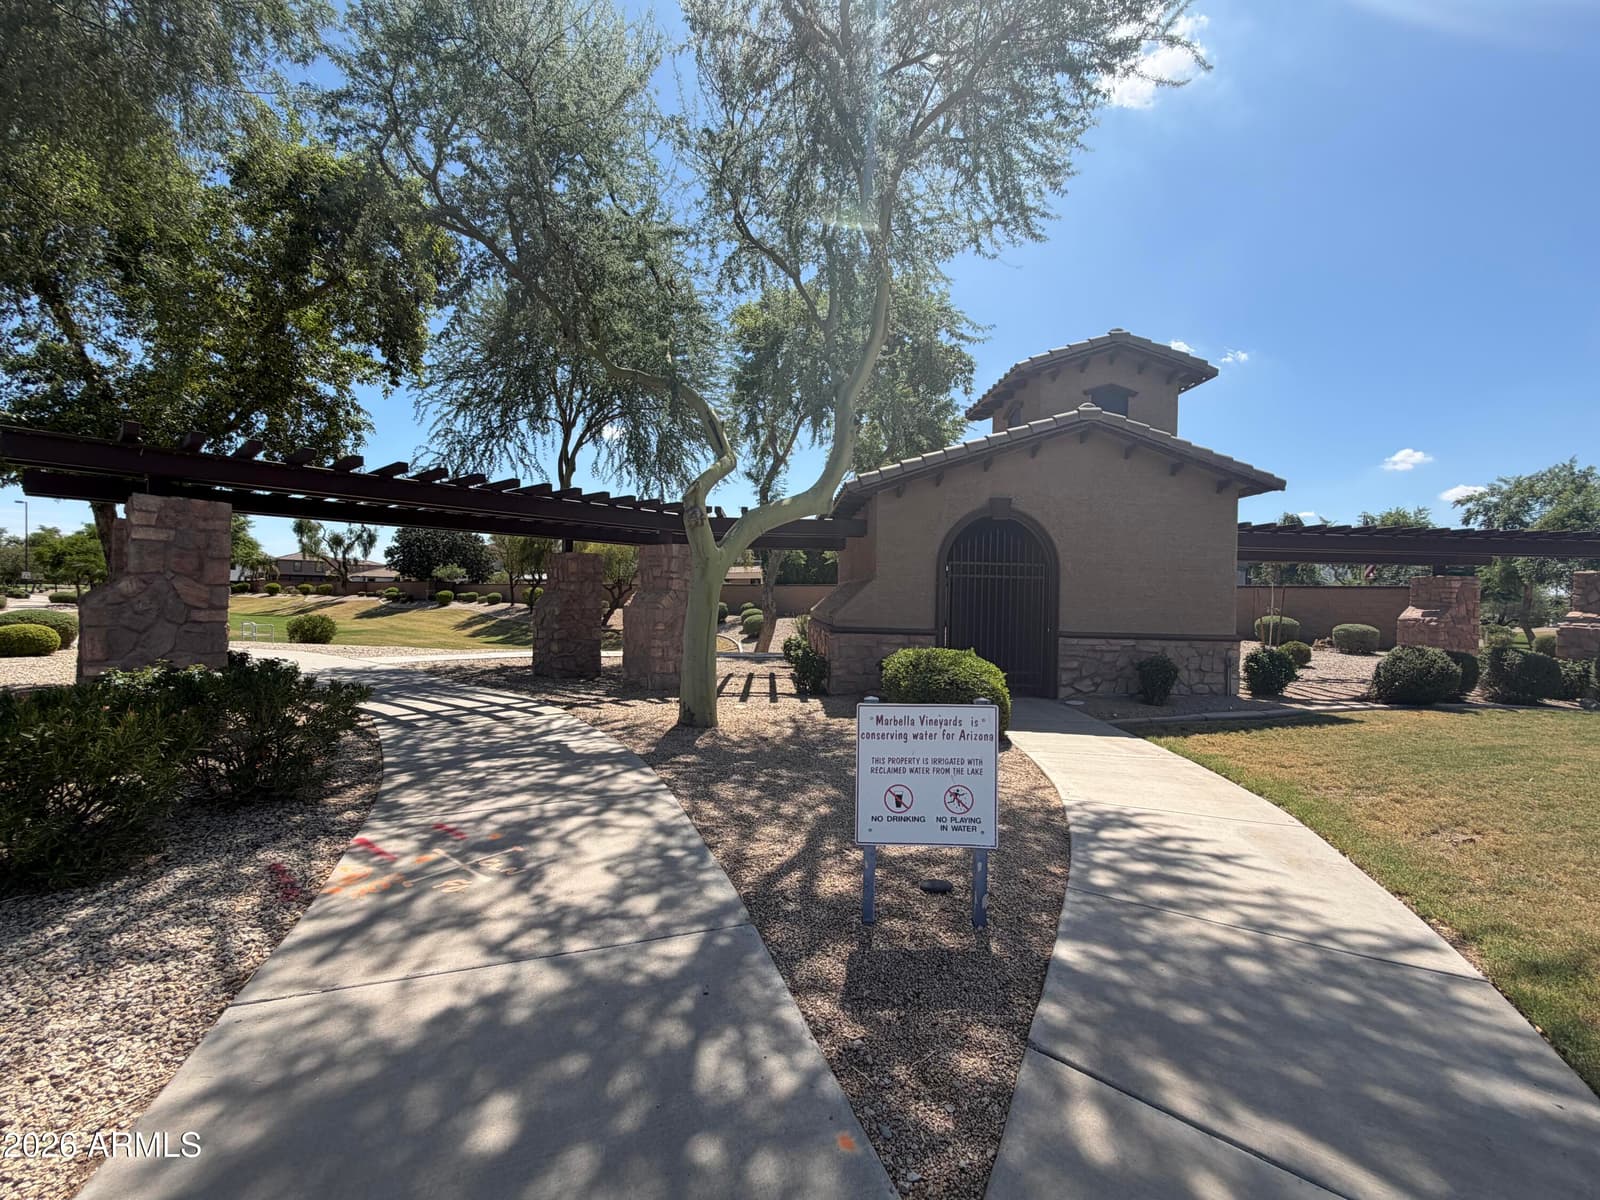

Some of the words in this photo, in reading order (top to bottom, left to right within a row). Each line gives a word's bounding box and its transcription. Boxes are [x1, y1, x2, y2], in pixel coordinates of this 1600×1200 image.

[875, 714, 915, 727] Marbella
[919, 715, 962, 729] Vineyards
[971, 716, 979, 728] is
[860, 730, 908, 743] conserving
[912, 731, 937, 741] water
[942, 729, 955, 740] for
[959, 729, 994, 742] Arizona
[871, 757, 886, 765] THIS
[887, 757, 920, 765] PROPERTY
[931, 758, 965, 766] IRRIGATED
[967, 758, 983, 766] WITH
[870, 766, 906, 774] RECLAIMED
[909, 767, 930, 775] WATER
[932, 767, 951, 775] FROM
[967, 768, 983, 776] LAKE
[871, 815, 883, 823] NO
[886, 815, 926, 823] DRINKING
[936, 816, 946, 824] NO
[950, 816, 982, 824] PLAYING
[950, 825, 977, 833] WATER
